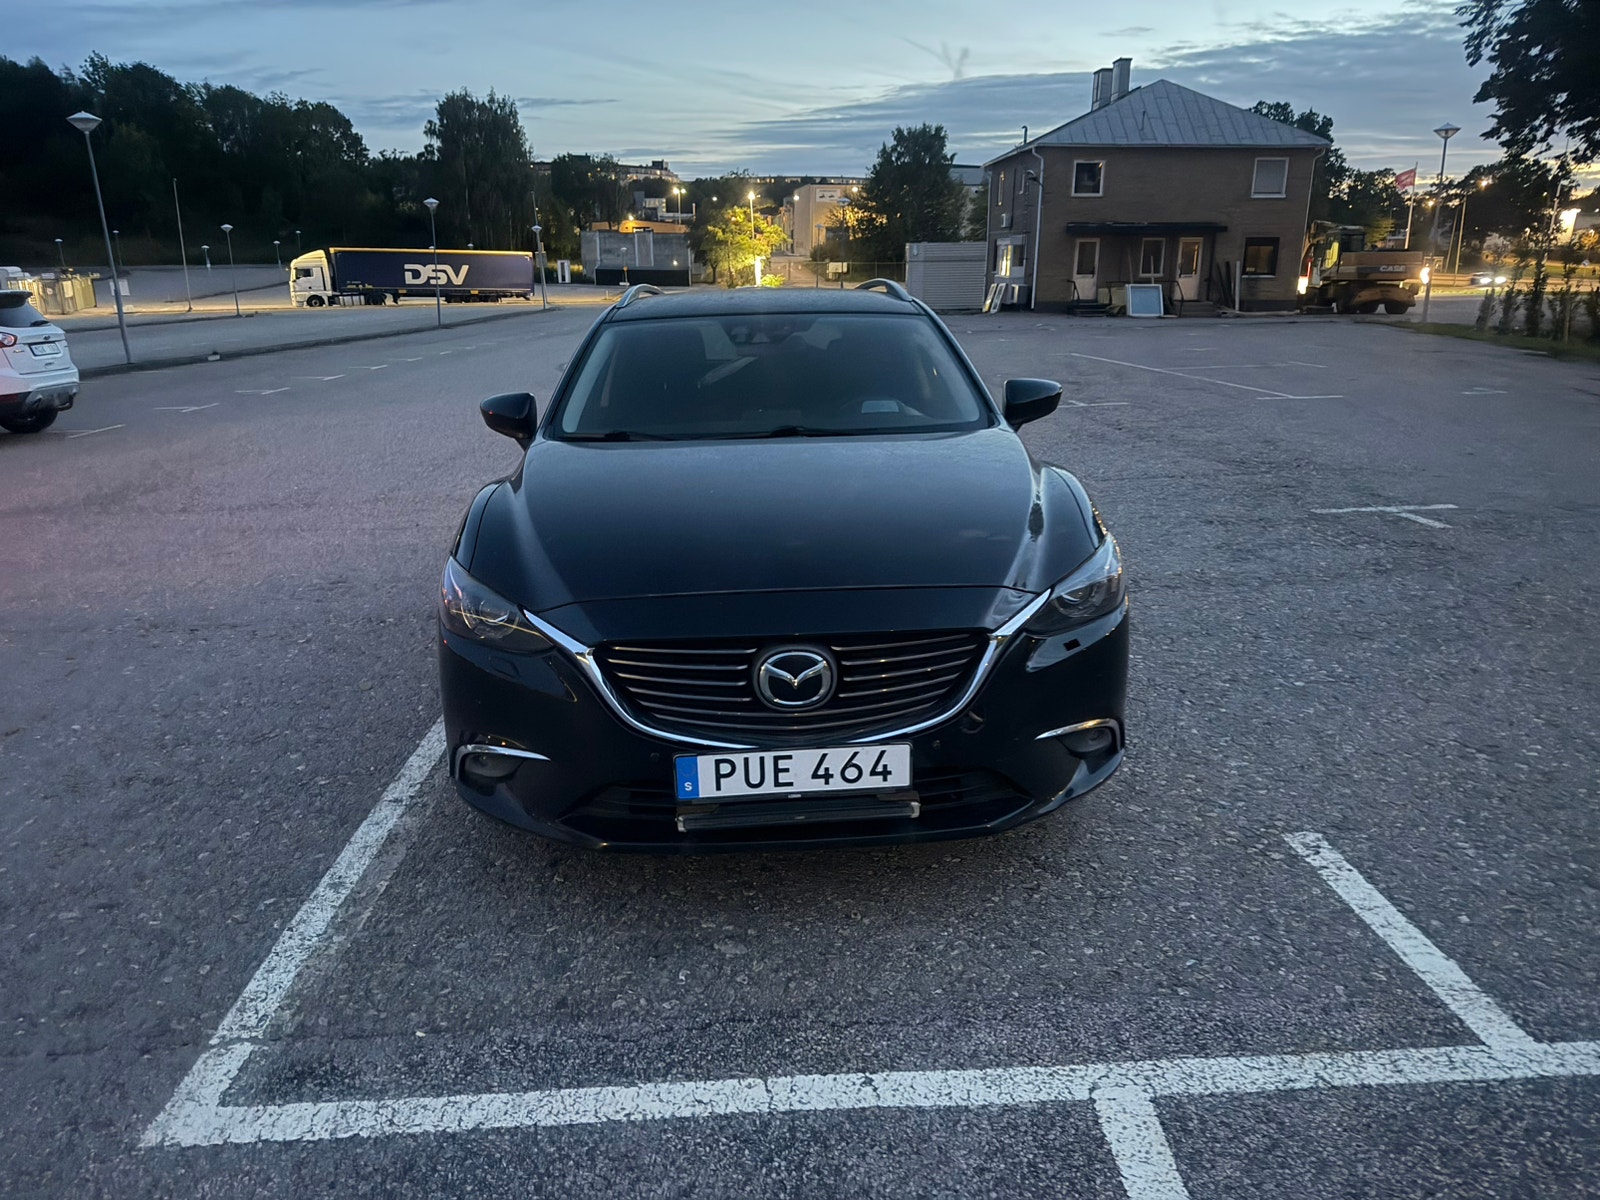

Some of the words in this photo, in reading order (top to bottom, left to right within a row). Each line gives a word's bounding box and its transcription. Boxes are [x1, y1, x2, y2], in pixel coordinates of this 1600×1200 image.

[404, 264, 469, 285] DSV
[714, 755, 794, 791] PUE
[811, 750, 892, 785] 464
[684, 781, 693, 791] S
